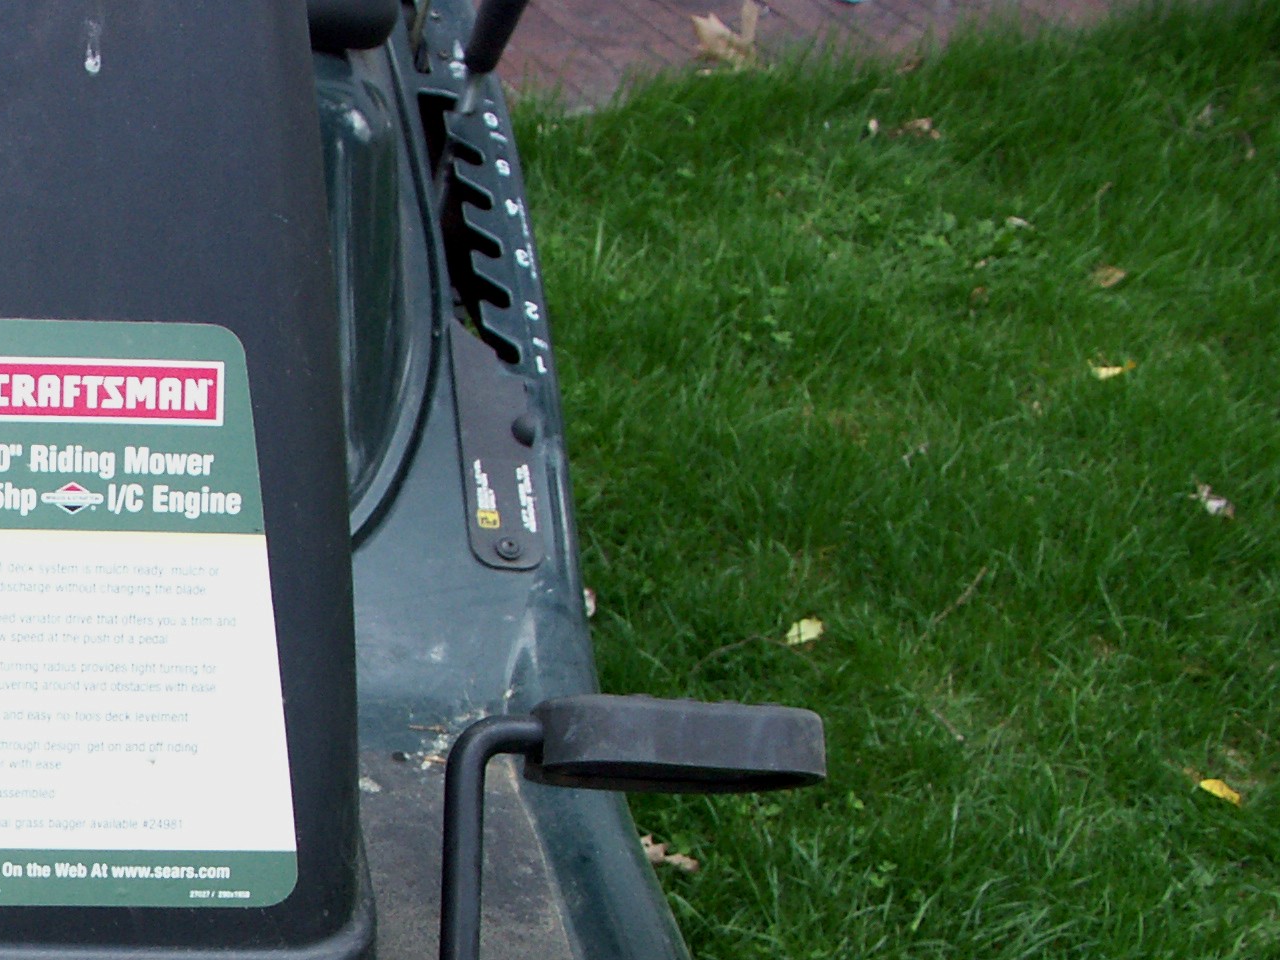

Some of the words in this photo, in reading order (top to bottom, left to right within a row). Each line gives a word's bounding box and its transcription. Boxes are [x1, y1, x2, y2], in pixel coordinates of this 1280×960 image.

[30, 444, 116, 480] Riding
[124, 446, 215, 477] Mower
[107, 483, 145, 516] I/C
[152, 484, 242, 519] Engine
[2, 862, 22, 877] On
[26, 862, 51, 878] the
[54, 863, 87, 878] Web
[90, 863, 108, 878] At
[111, 864, 231, 879] www.sears.com
